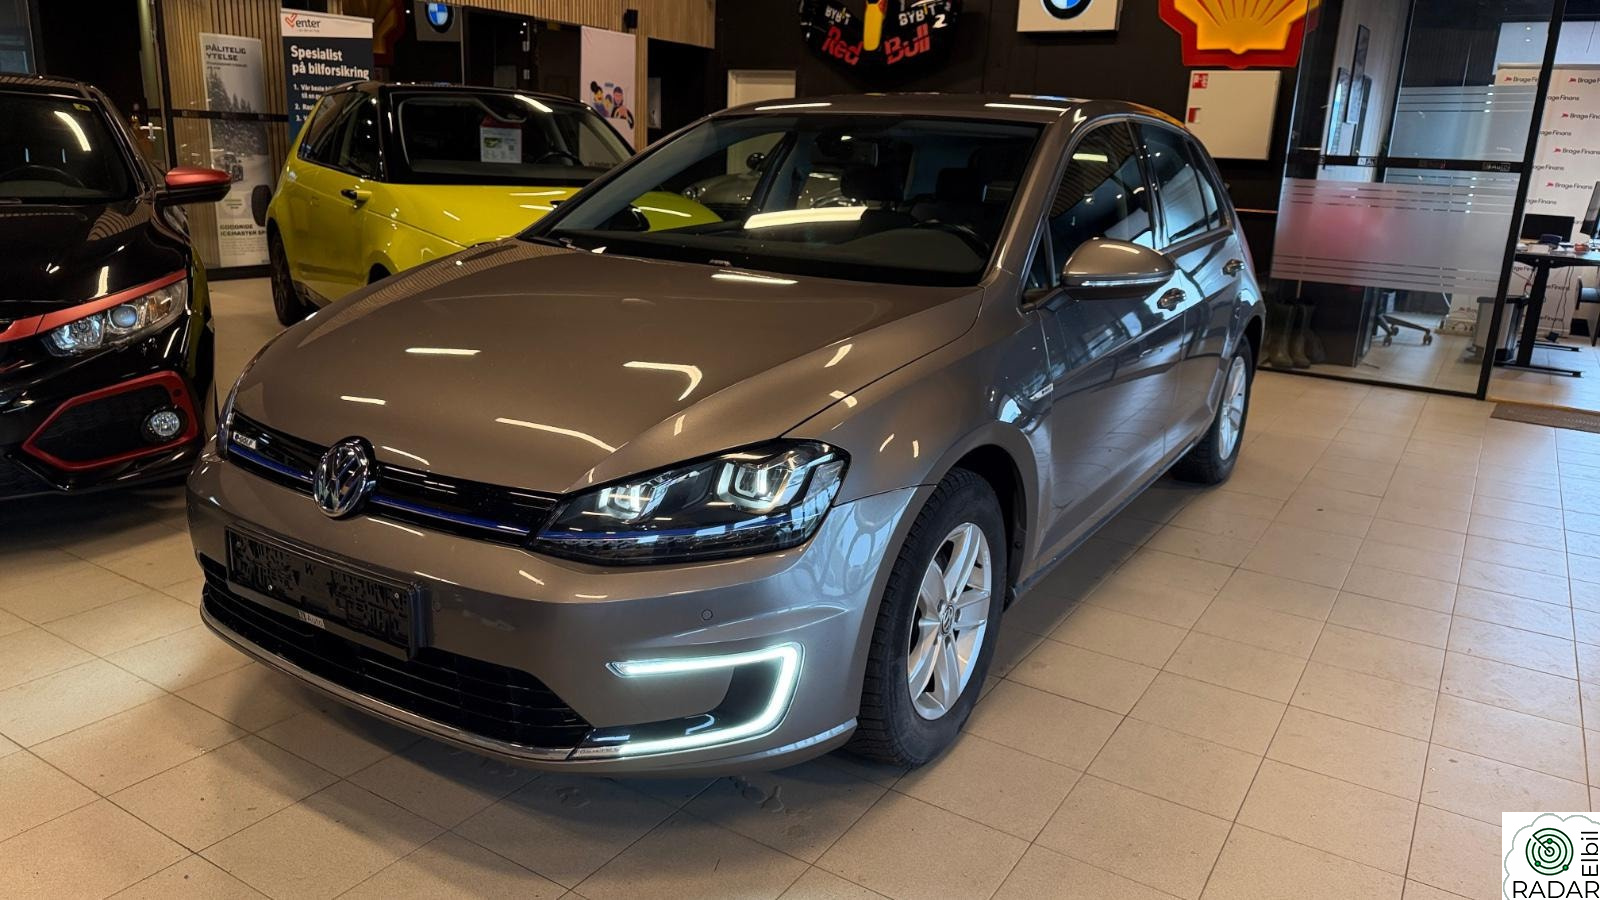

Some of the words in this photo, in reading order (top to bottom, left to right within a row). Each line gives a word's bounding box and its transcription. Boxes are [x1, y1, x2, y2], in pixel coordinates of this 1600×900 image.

[932, 13, 948, 29] 2
[821, 25, 864, 65] Red
[884, 23, 931, 65] Bull
[206, 52, 239, 61] YTELSE
[290, 44, 343, 62] Spesialist
[292, 61, 306, 76] på
[308, 62, 370, 81] bilforsikring
[1570, 112, 1588, 120] Brage
[1562, 147, 1580, 155] Brage
